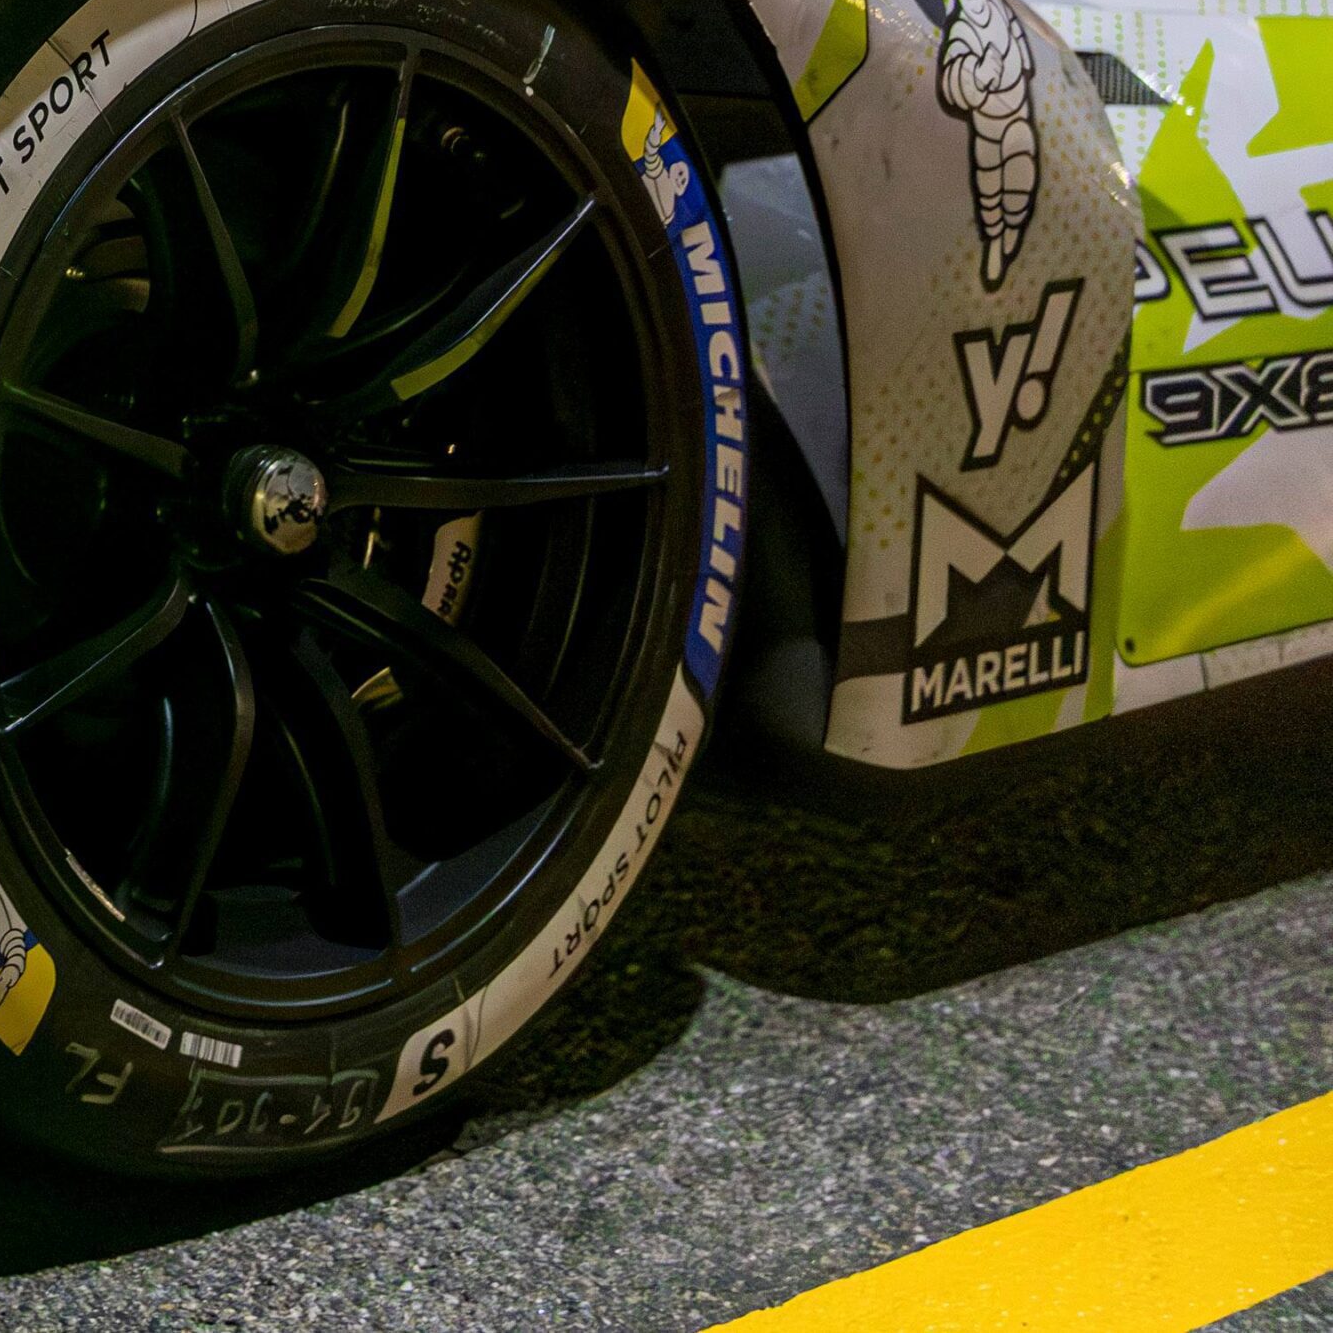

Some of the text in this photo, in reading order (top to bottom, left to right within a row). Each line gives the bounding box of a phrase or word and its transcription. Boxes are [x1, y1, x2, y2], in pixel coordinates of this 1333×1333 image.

[12, 29, 111, 164] SPORT
[679, 219, 745, 656] MICHELIN
[910, 630, 1087, 714] MARELLI
[548, 729, 688, 979] PILOT SPORT
